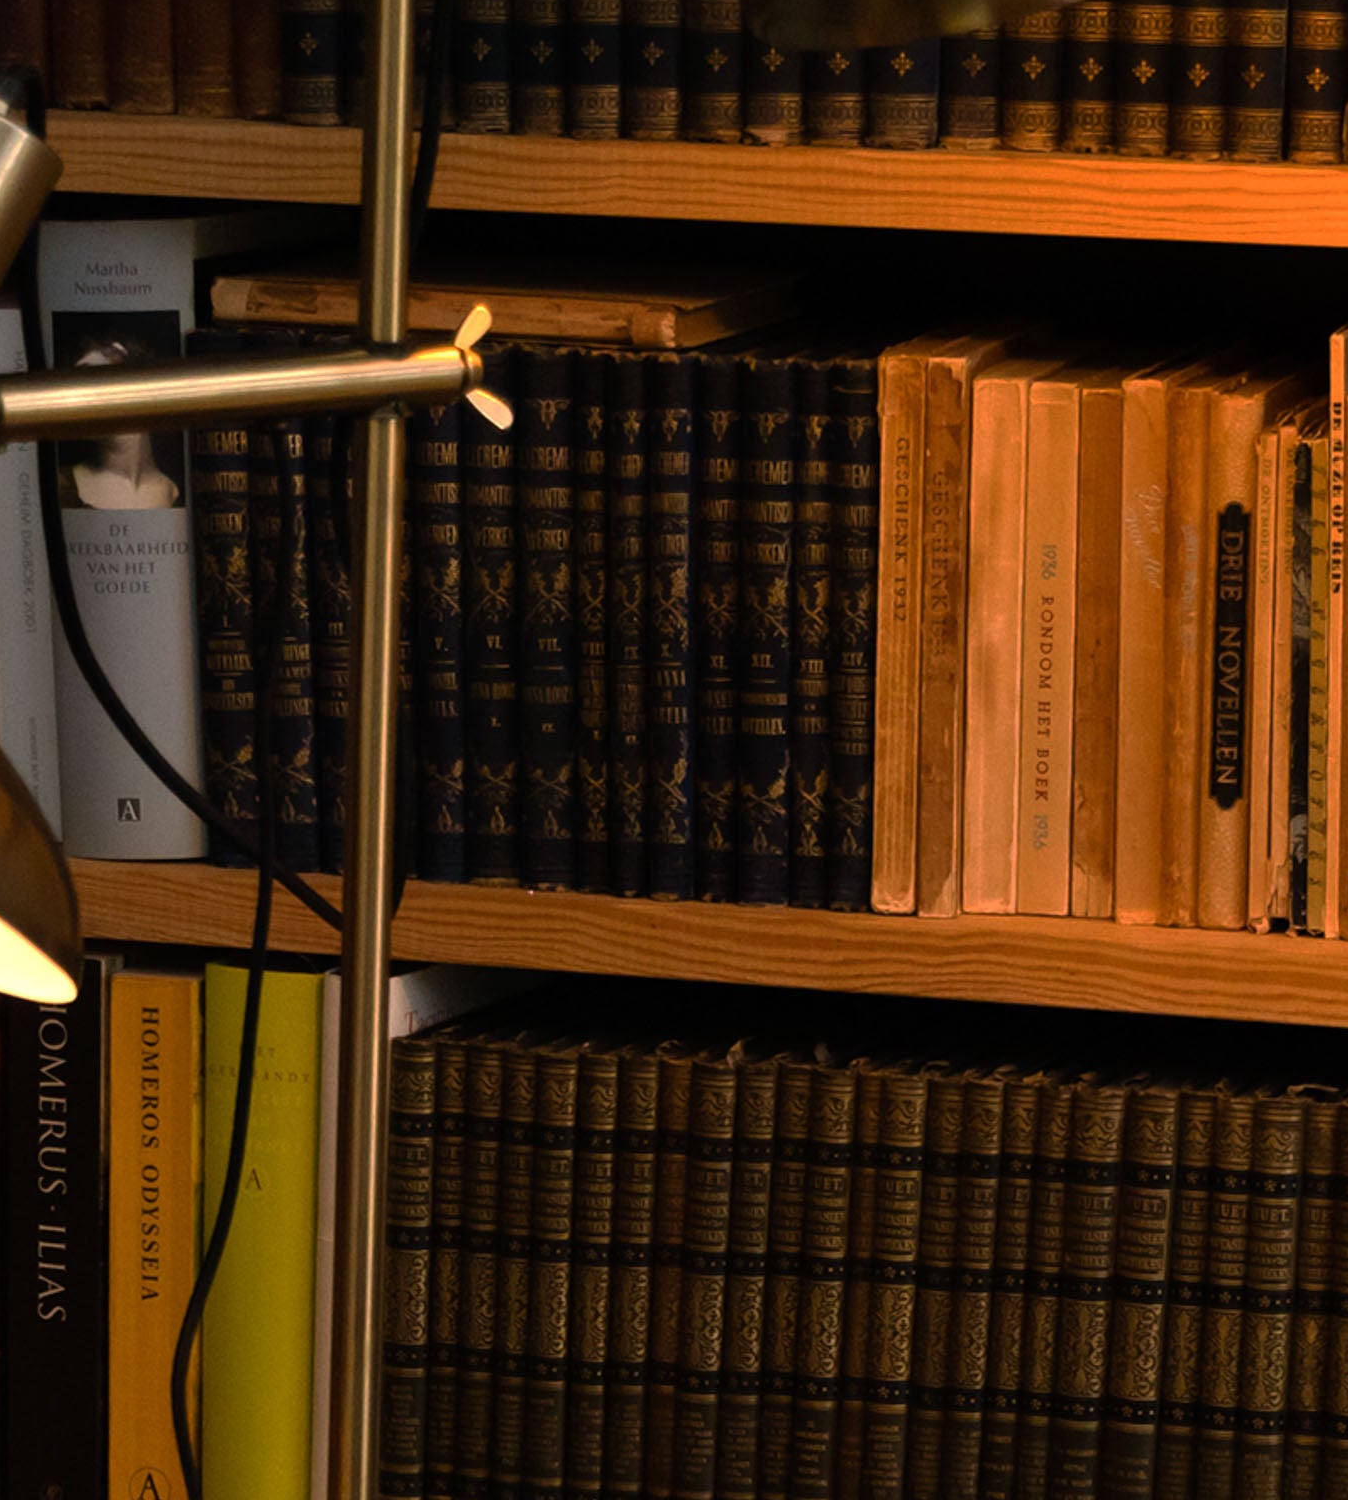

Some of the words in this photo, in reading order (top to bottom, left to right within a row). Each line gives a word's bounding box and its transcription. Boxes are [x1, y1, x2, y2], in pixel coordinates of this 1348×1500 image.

[1219, 529, 1244, 600] DRIE
[1037, 596, 1055, 690] RONDOM
[1037, 701, 1052, 738] HET
[1215, 626, 1242, 784] NOVELLEN
[1034, 748, 1051, 800] BOEK
[141, 1007, 160, 1149] HOMEROS
[36, 1223, 69, 1322] ILIAS
[141, 1164, 160, 1302] ODYSSEIA
